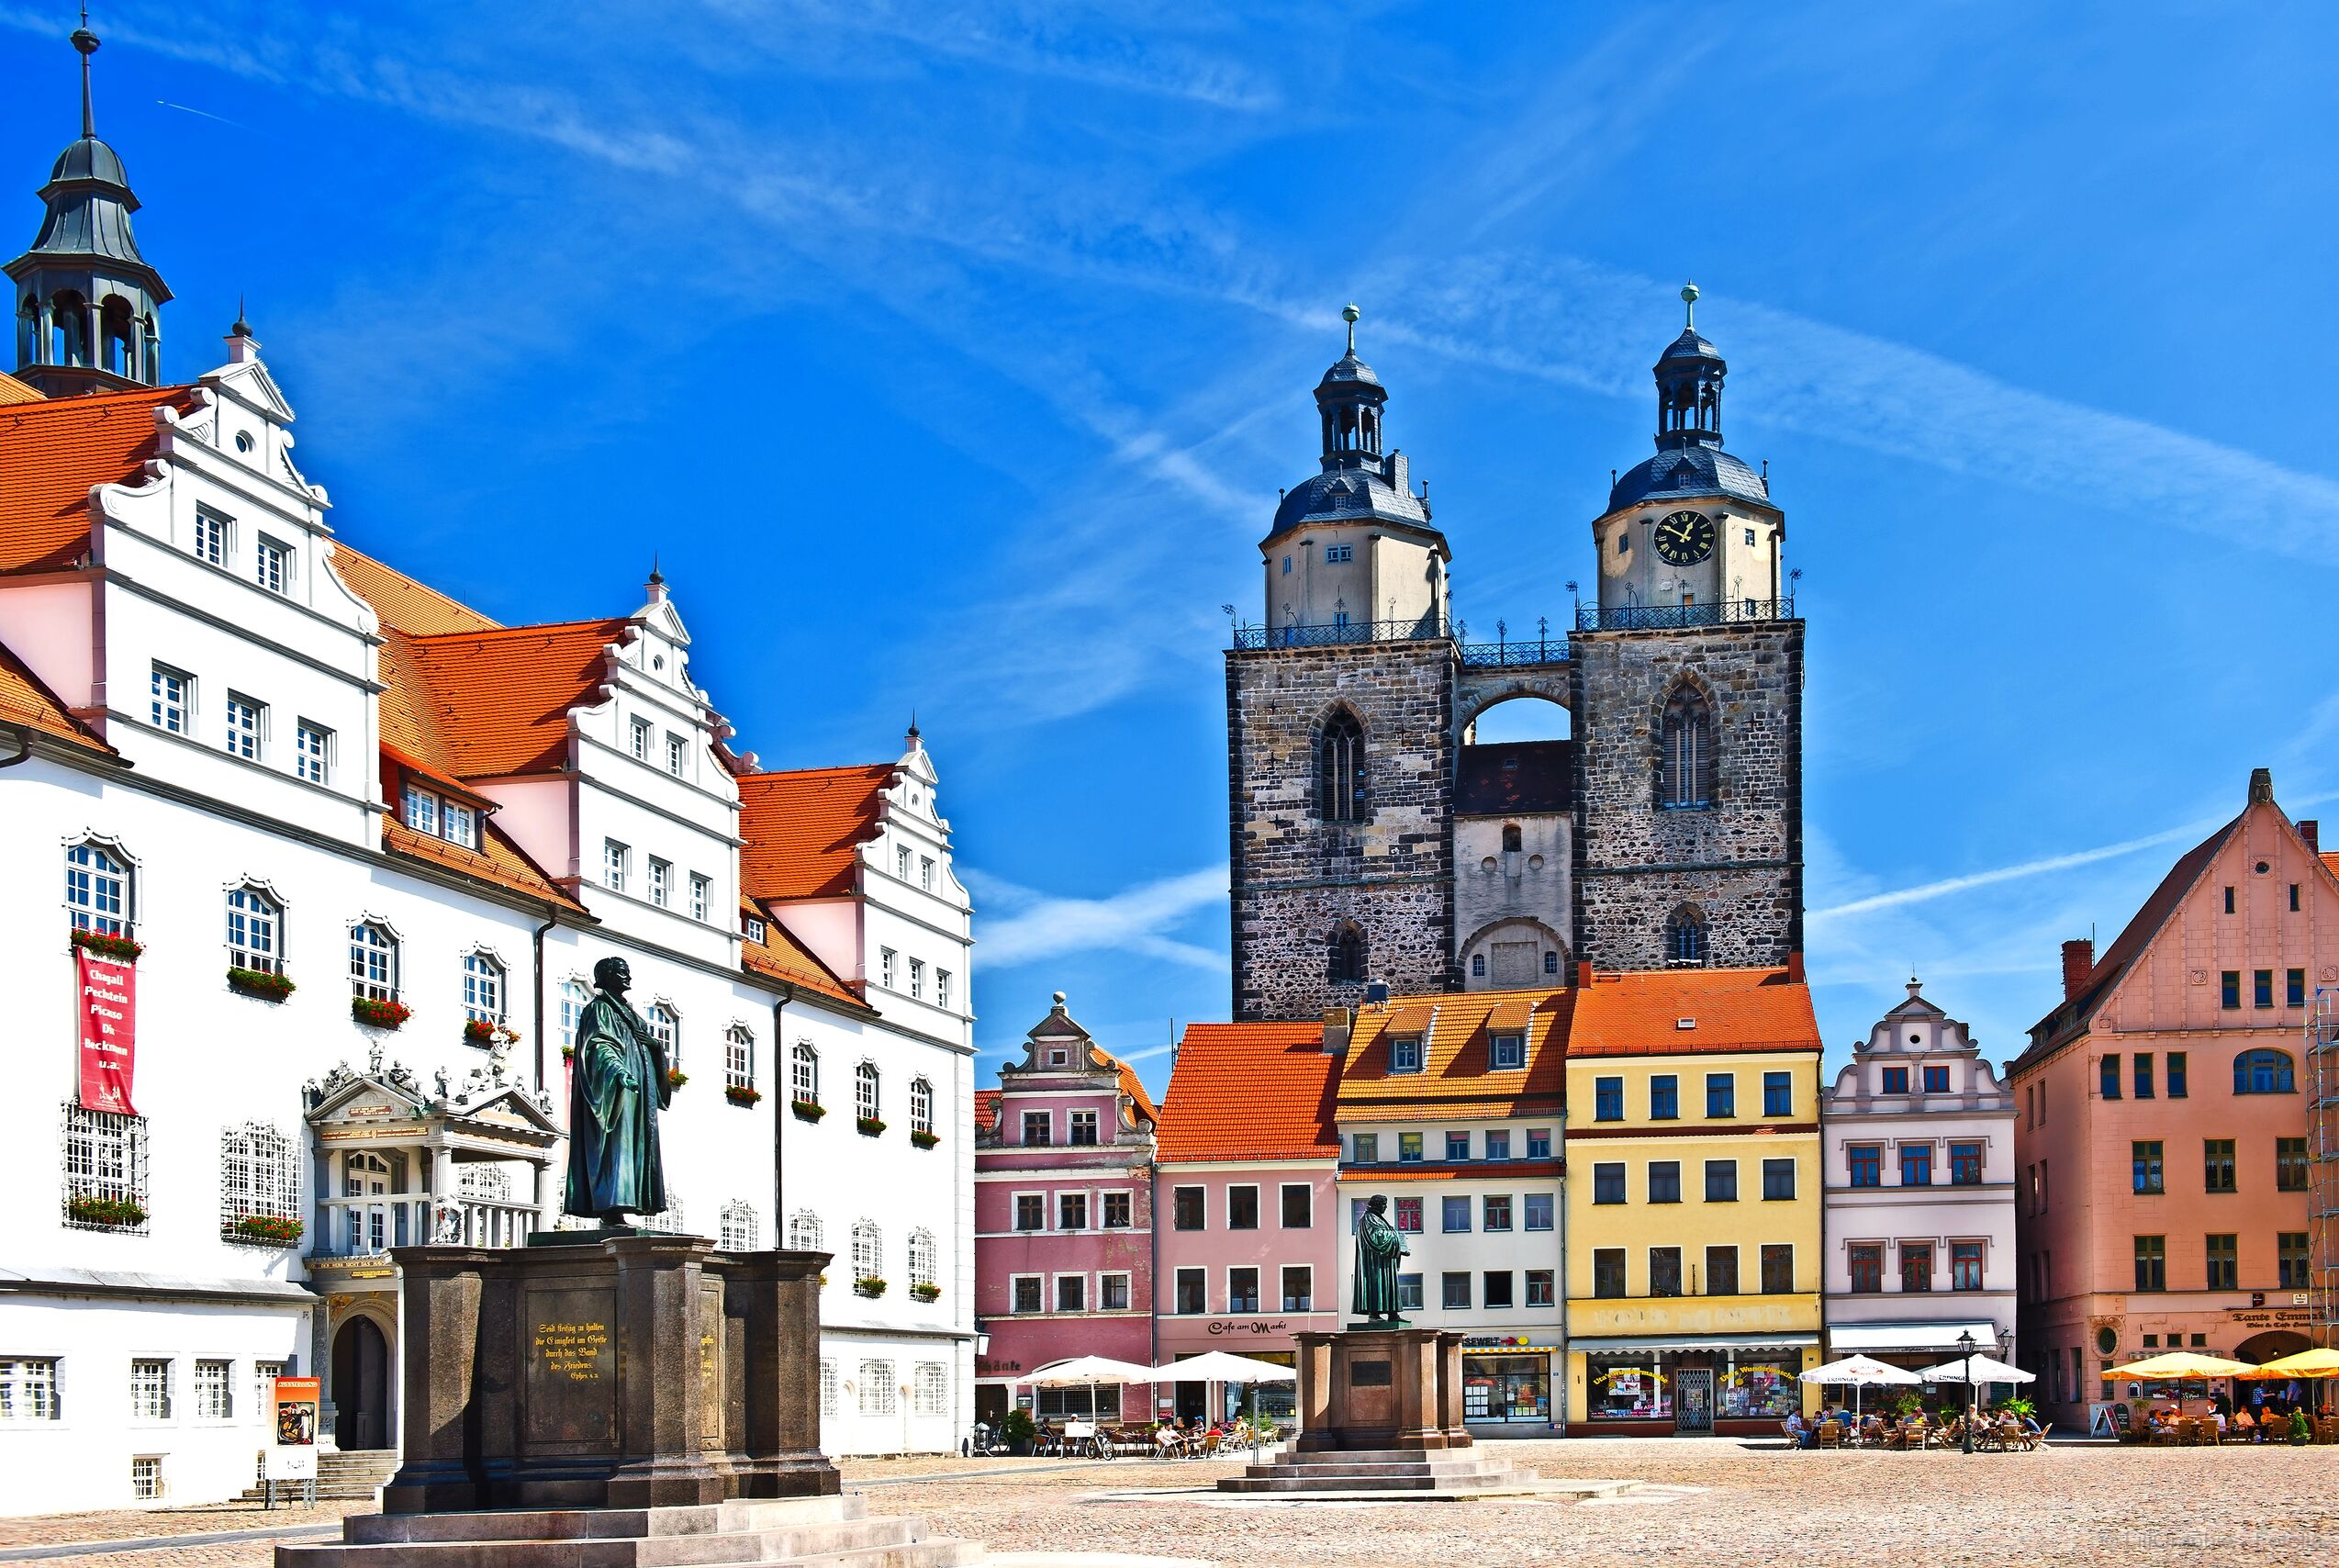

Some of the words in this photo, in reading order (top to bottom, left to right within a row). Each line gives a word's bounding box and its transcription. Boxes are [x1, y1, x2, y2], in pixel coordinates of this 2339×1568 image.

[89, 969, 124, 986] Chagall
[84, 985, 128, 1003] Pechstein
[98, 1060, 120, 1070] u.a.
[2233, 1313, 2270, 1322] Tante
[1208, 1322, 1235, 1335] Cafe
[1250, 1321, 1287, 1334] Markt
[1462, 1337, 1500, 1347] SEWELT
[1740, 1365, 1796, 1382] Wundermasche
